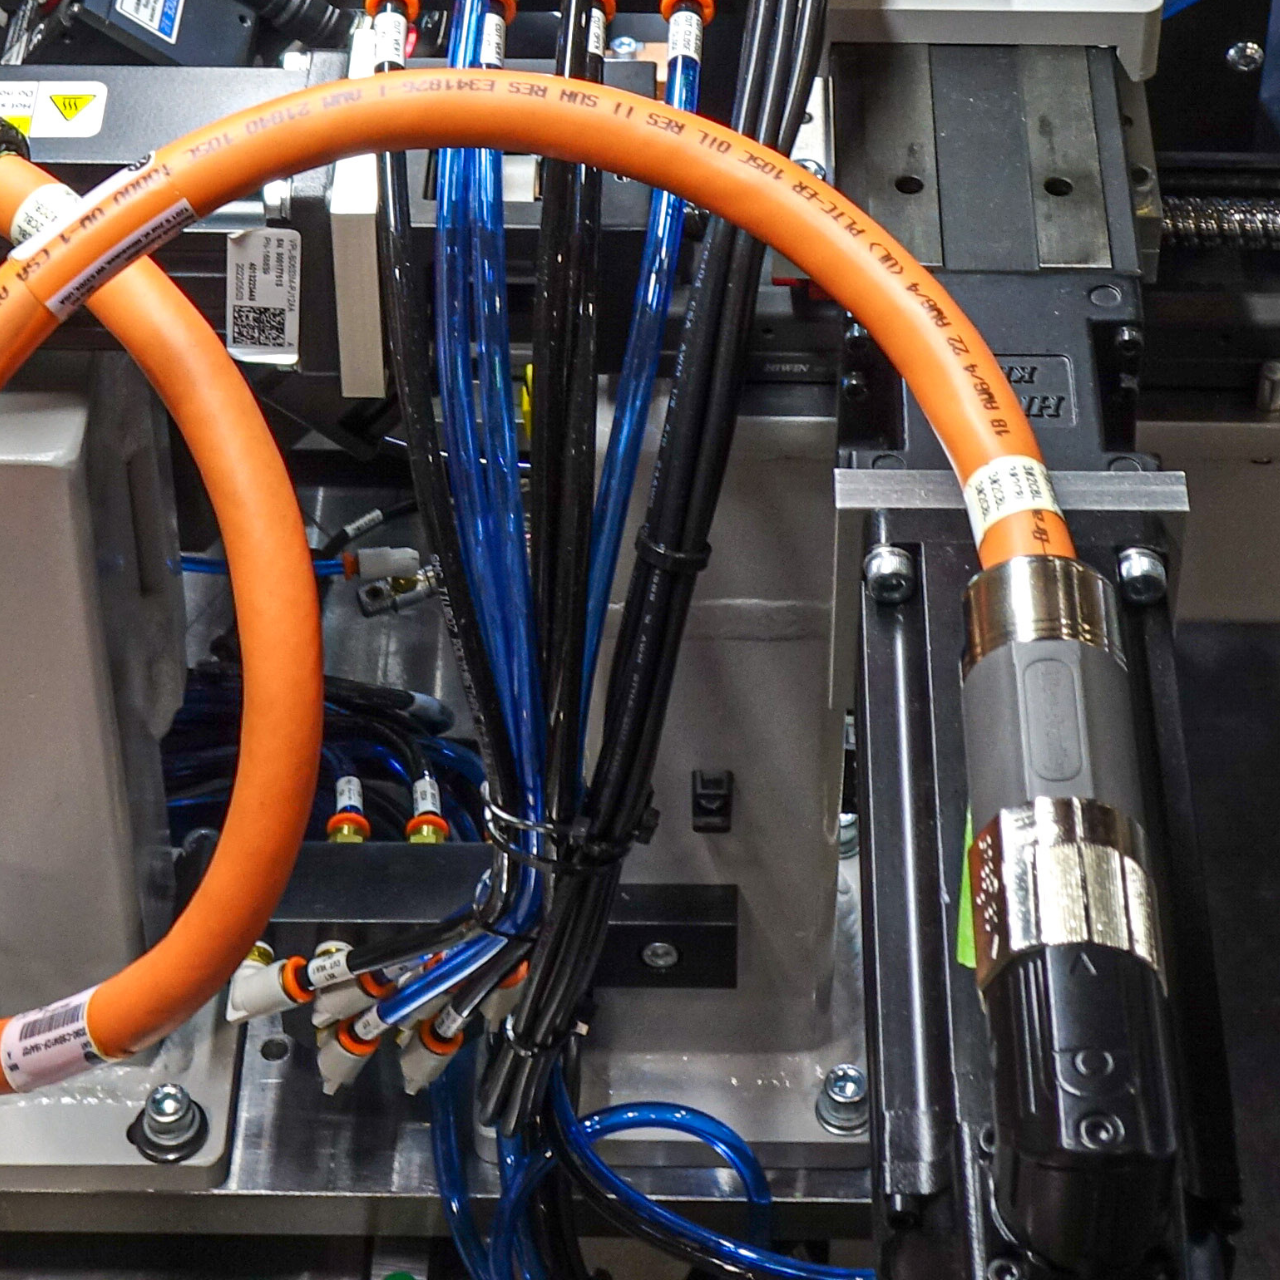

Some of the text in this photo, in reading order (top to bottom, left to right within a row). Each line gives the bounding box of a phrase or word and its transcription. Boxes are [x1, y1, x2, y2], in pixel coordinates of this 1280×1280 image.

[591, 15, 601, 55] CUT OPEN
[494, 40, 502, 65] VERT
[507, 81, 548, 99] RES
[559, 90, 600, 108] SUN
[646, 112, 685, 136] RES
[697, 128, 732, 154] OIL
[738, 149, 786, 182] 105C
[791, 179, 866, 238] PLTC-ER
[15, 248, 51, 282] CSA
[869, 241, 904, 275] (UL)
[59, 290, 74, 305] USA
[906, 282, 952, 328] AWG/4
[946, 334, 970, 356] 22
[963, 363, 1000, 410] AWG/4
[990, 418, 1011, 437] 18
